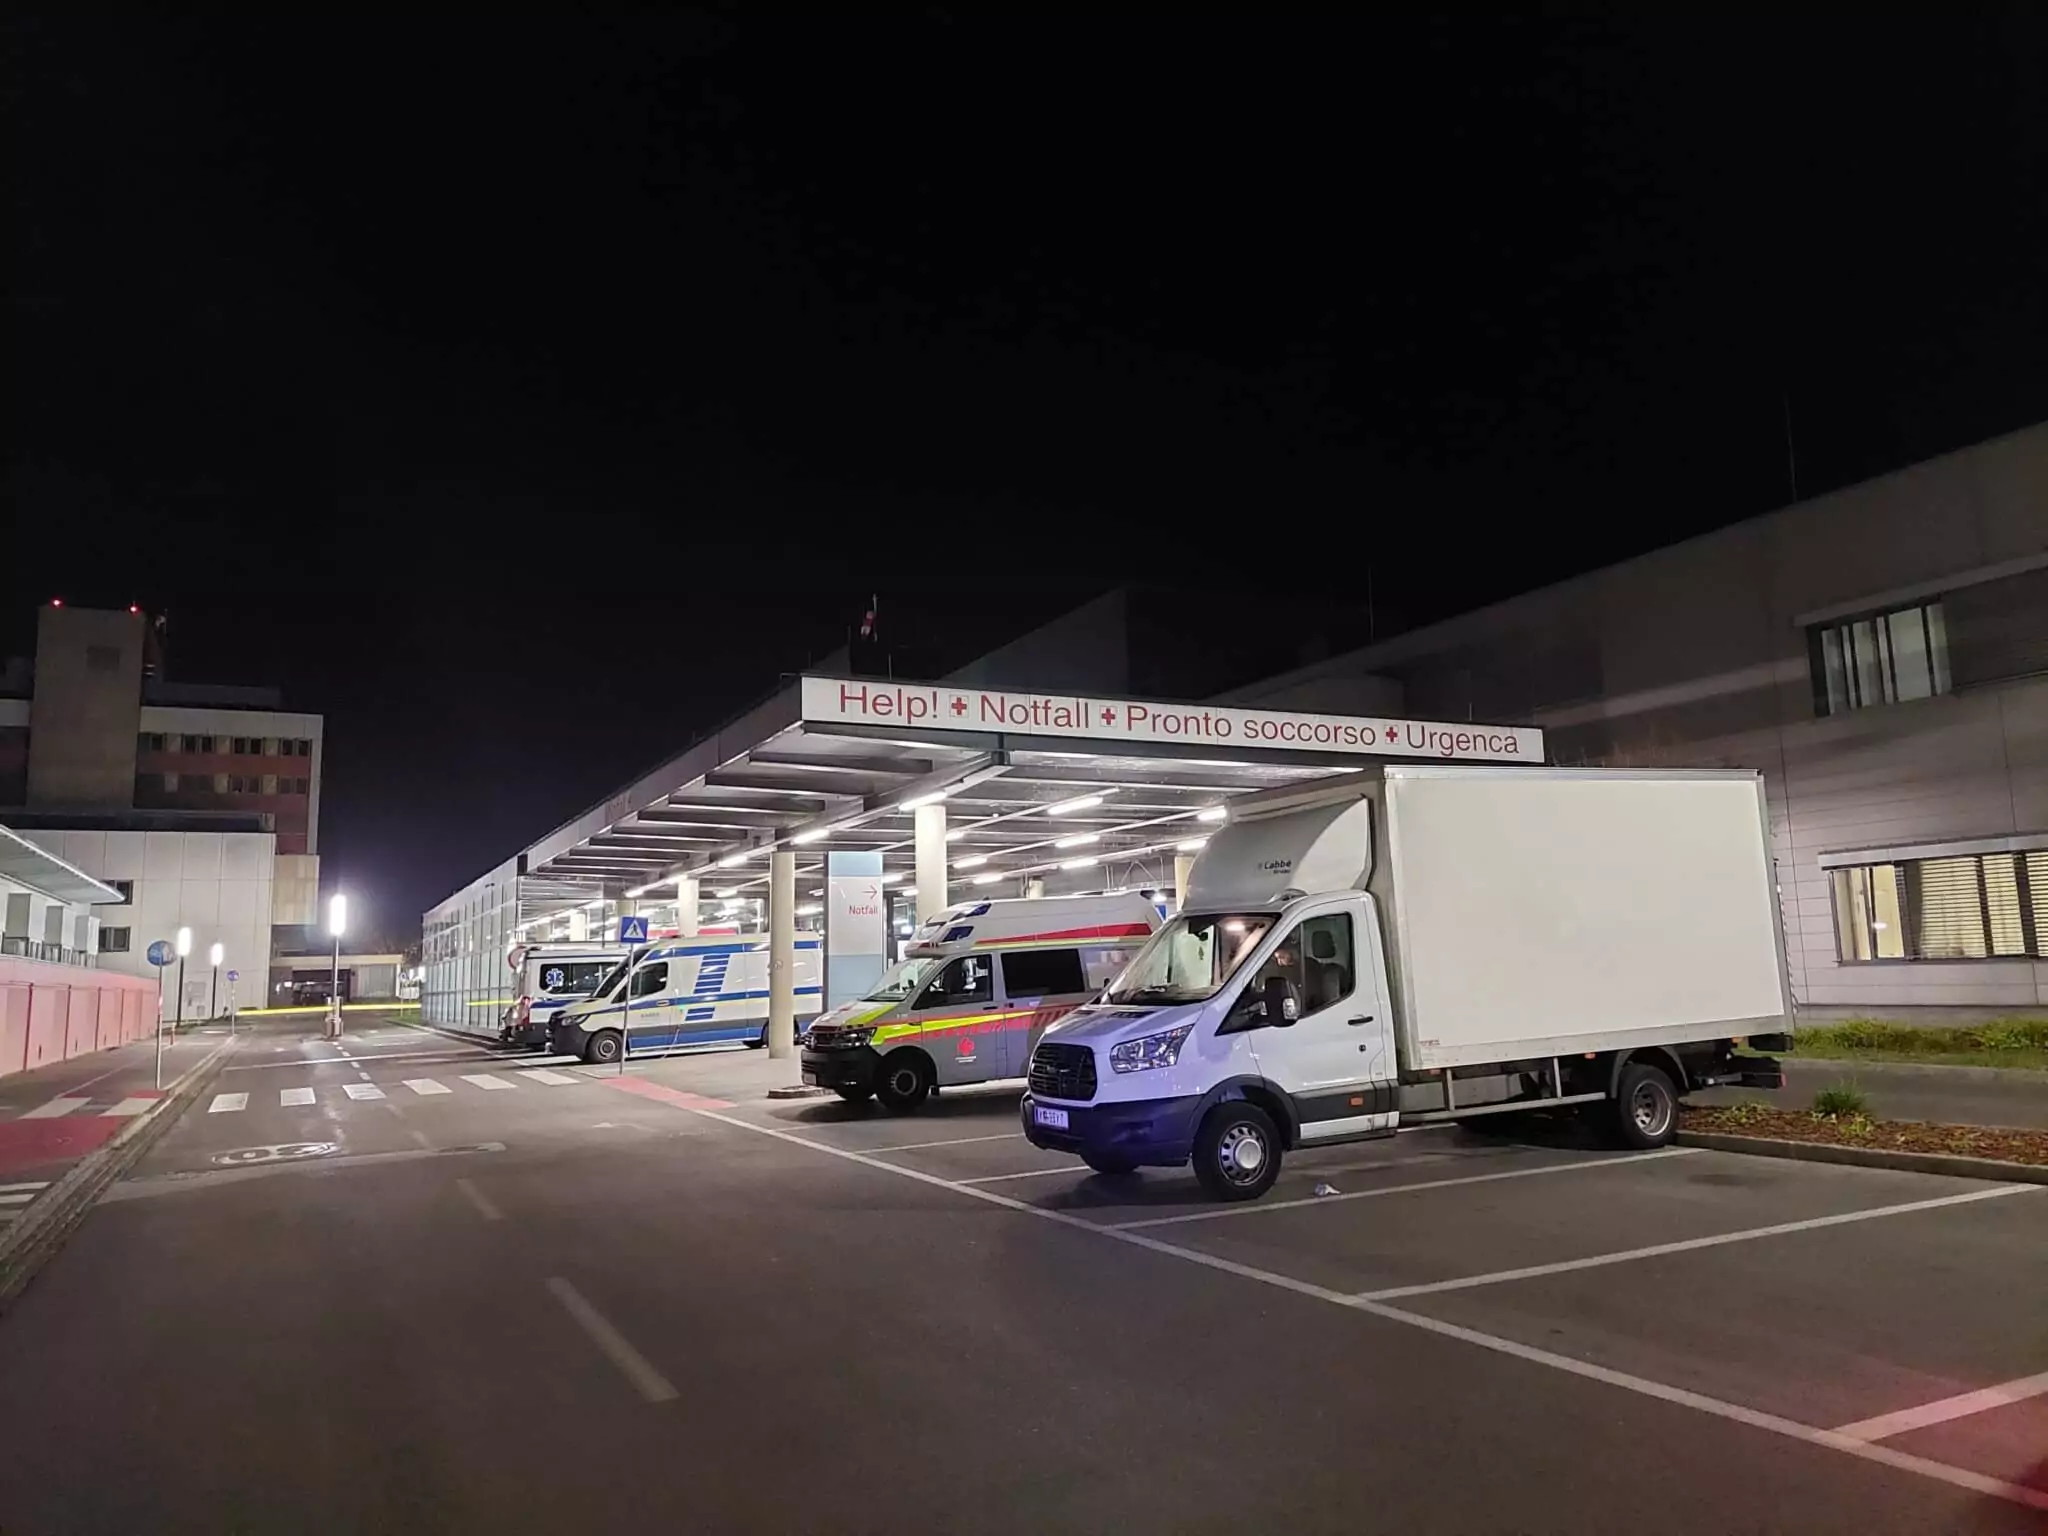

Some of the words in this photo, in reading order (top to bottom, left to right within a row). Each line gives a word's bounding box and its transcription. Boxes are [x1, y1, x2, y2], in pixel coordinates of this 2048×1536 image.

[840, 684, 938, 724] Help!
[980, 695, 1089, 728] Notfall
[1127, 704, 1232, 737] Pronto
[1243, 719, 1376, 746] soccorso
[1406, 724, 1519, 756] Urgenca
[849, 904, 878, 915] Notfall
